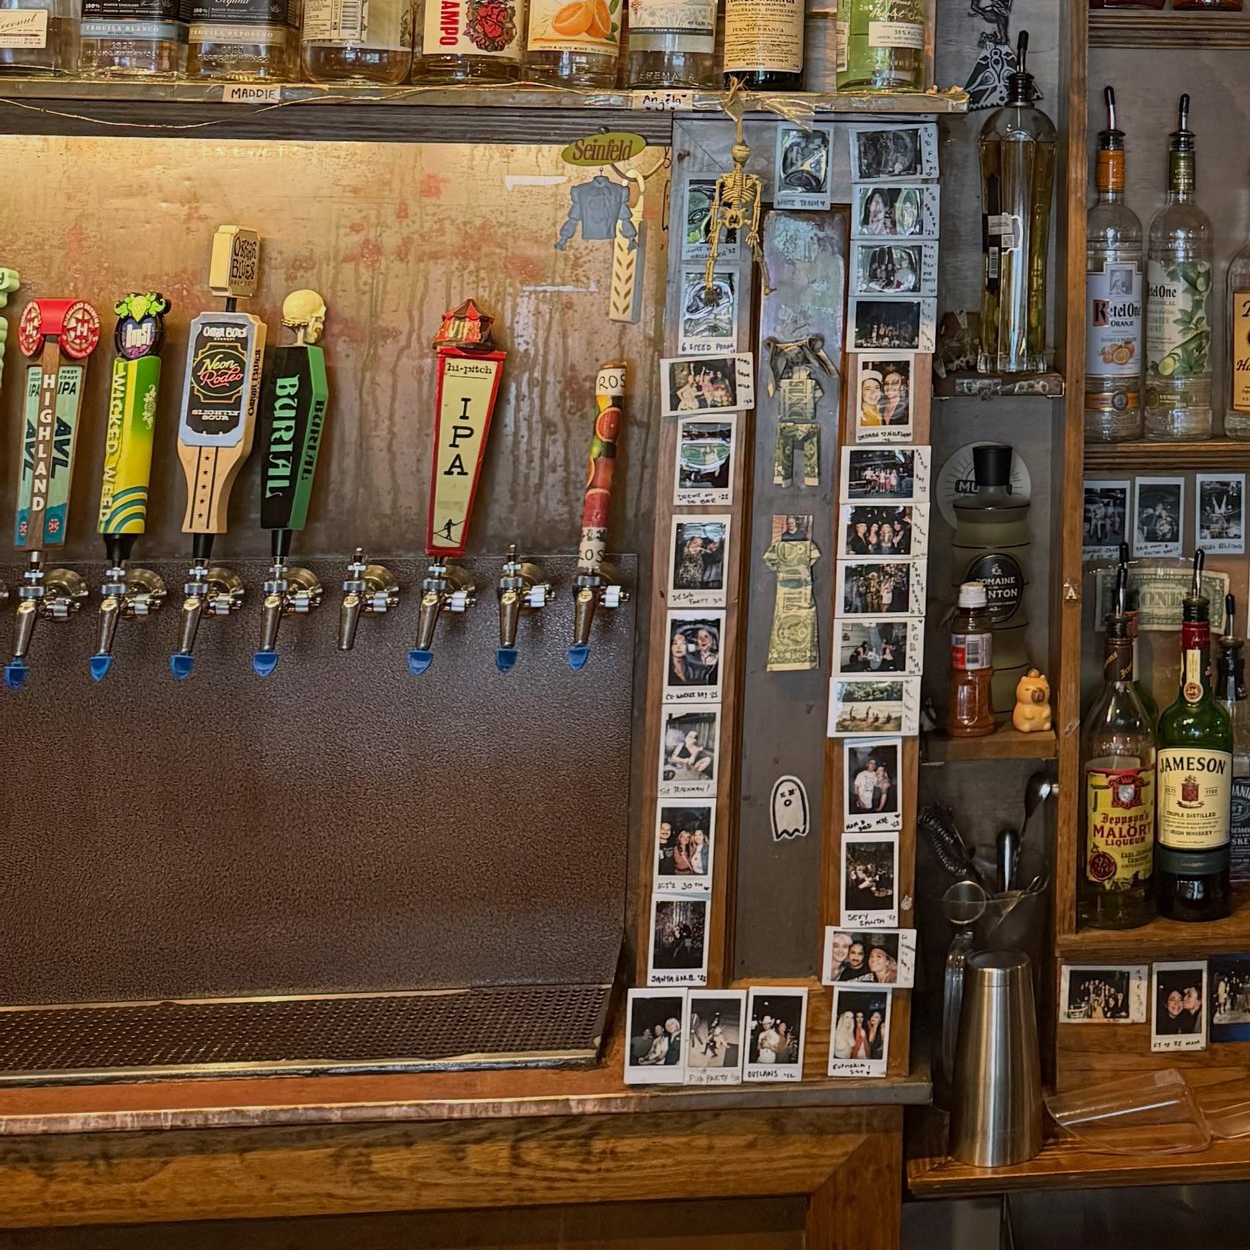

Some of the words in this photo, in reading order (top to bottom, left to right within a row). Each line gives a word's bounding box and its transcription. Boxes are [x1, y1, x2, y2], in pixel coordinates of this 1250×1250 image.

[85, 23, 119, 32] TEQUILA
[121, 25, 160, 34] BLANCO
[231, 88, 277, 100] MADDIE
[572, 138, 634, 162] Seinfeld
[1159, 285, 1177, 298] One
[197, 354, 236, 376] Neon
[446, 362, 493, 376] hi-pitch
[200, 366, 244, 388] Rodeo
[57, 382, 76, 395] IPA
[106, 370, 127, 454] WICKED
[191, 409, 241, 418] SLIGHTLY
[32, 375, 56, 511] HIGHLAND
[265, 374, 299, 499] BURIAL
[443, 397, 475, 477] IPA
[50, 416, 71, 480] AVL
[99, 464, 117, 523] WEED
[976, 576, 1015, 586] DOMAINE
[988, 588, 1018, 598] NTON
[1159, 757, 1227, 776] JAMESON
[1101, 812, 1150, 827] Jeppson's
[1105, 837, 1146, 847] LIQUEUR
